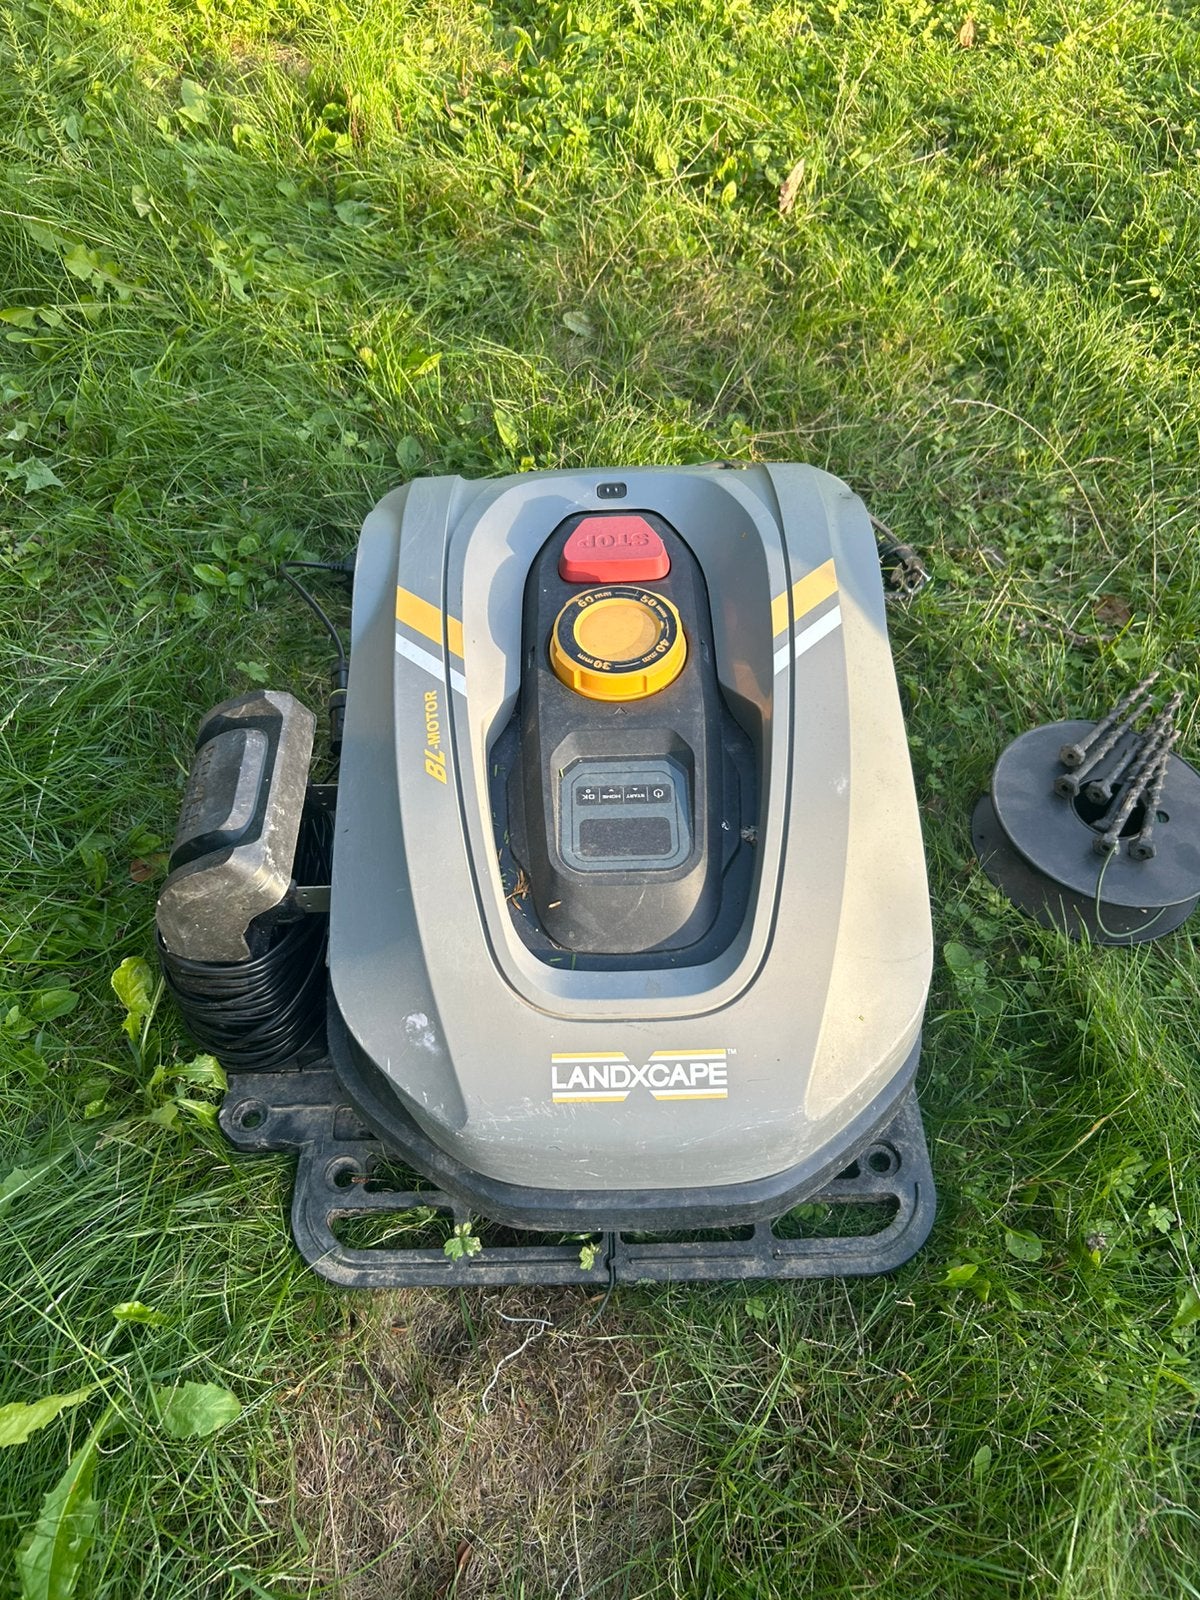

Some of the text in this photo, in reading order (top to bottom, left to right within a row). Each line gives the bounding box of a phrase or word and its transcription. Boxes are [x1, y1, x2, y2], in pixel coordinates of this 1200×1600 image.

[577, 532, 650, 549] STOP
[577, 591, 612, 608] 60 mm
[640, 594, 658, 607] 50
[655, 638, 670, 653] 40
[577, 652, 612, 671] 30 mm
[424, 689, 448, 785] BL-MOTOR
[551, 1062, 728, 1090] LANDXCAPE
